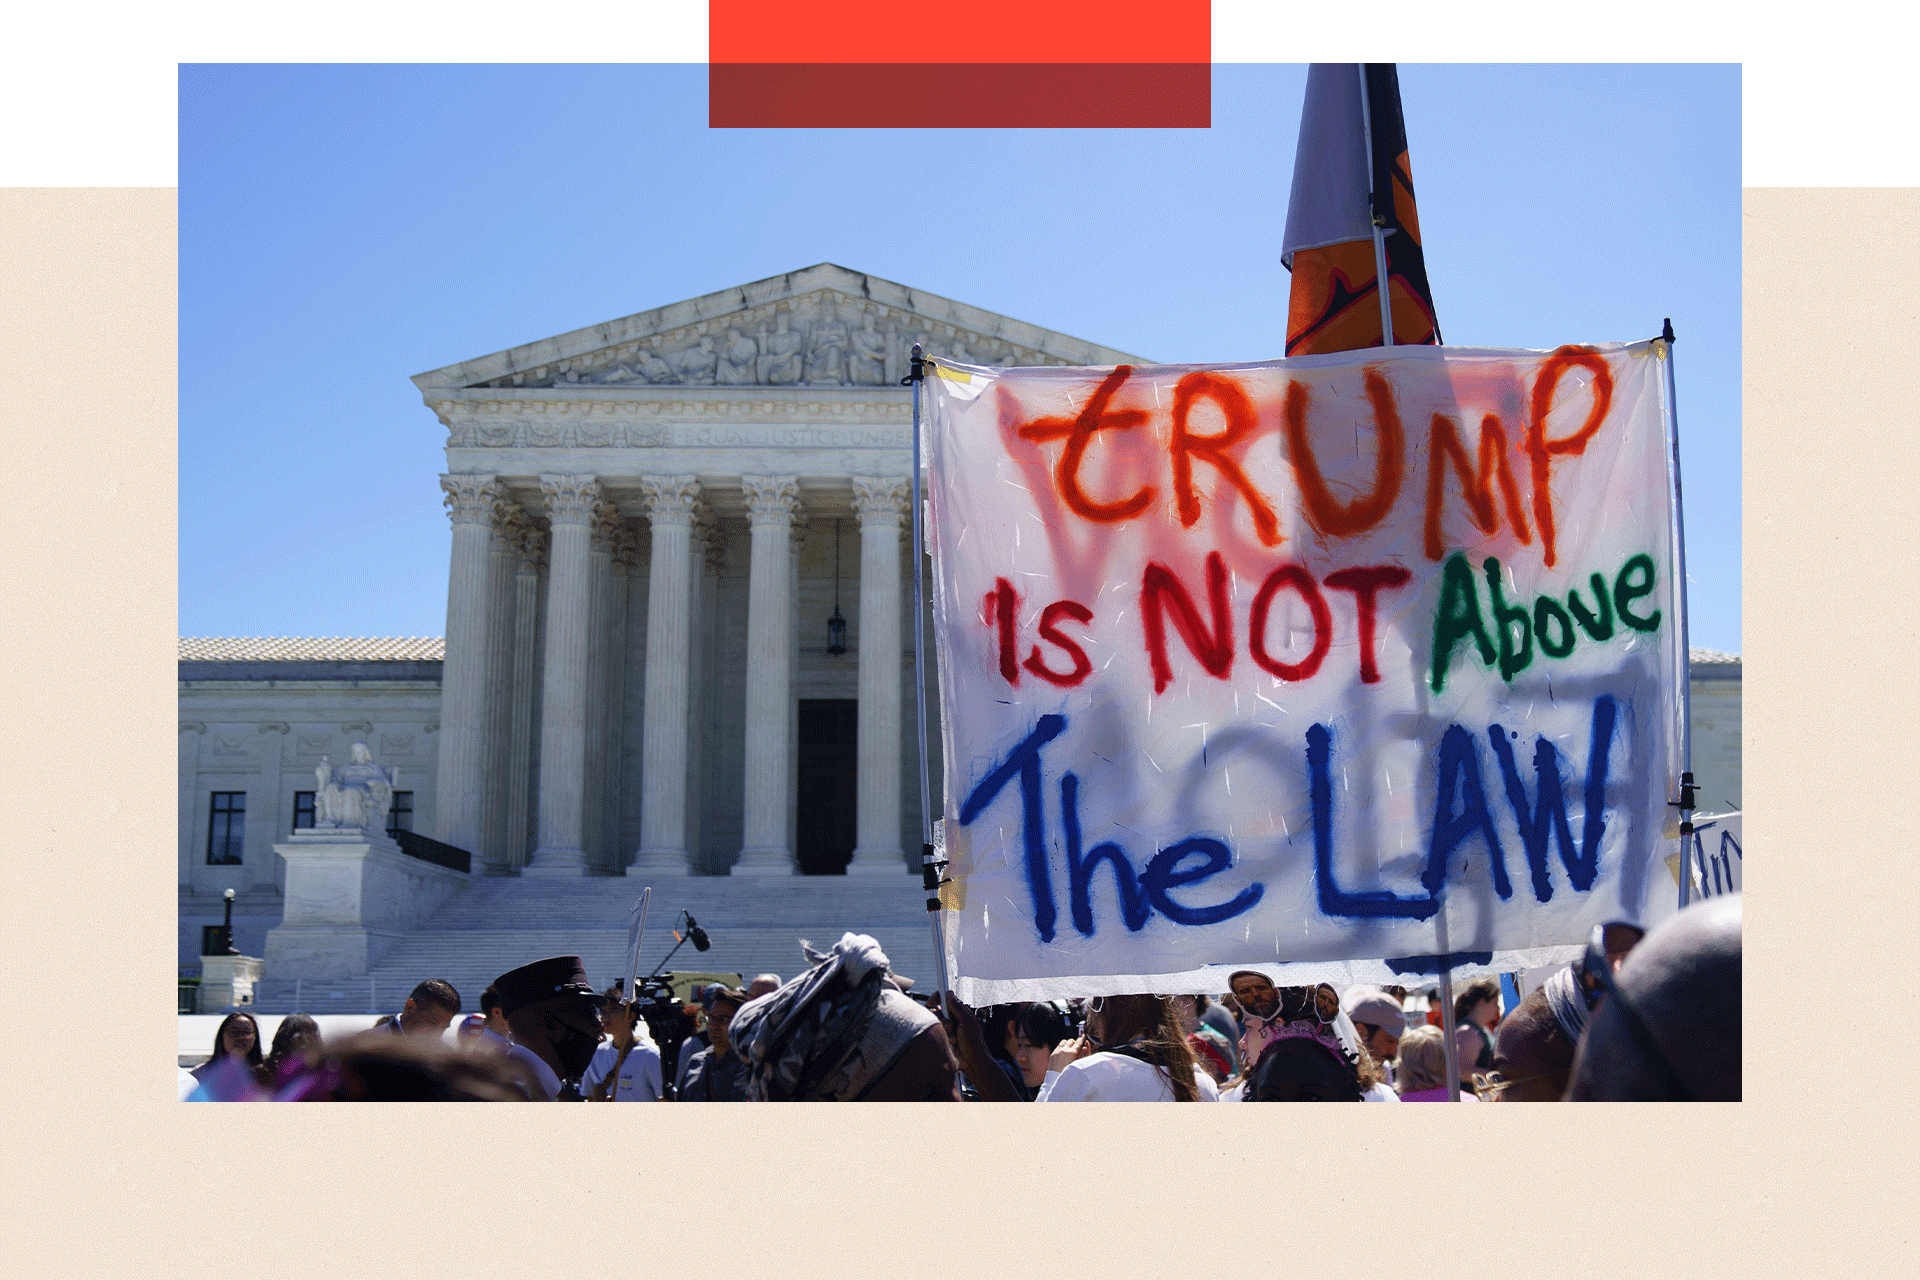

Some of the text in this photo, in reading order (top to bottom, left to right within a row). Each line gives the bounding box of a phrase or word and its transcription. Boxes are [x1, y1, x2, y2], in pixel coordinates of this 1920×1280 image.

[684, 428, 755, 446] EQUAL
[761, 429, 839, 445] JUSTICE
[1140, 550, 1411, 694] NOT
[1429, 551, 1662, 696] Above
[961, 714, 1264, 942] The
[1305, 694, 1620, 922] LAW
